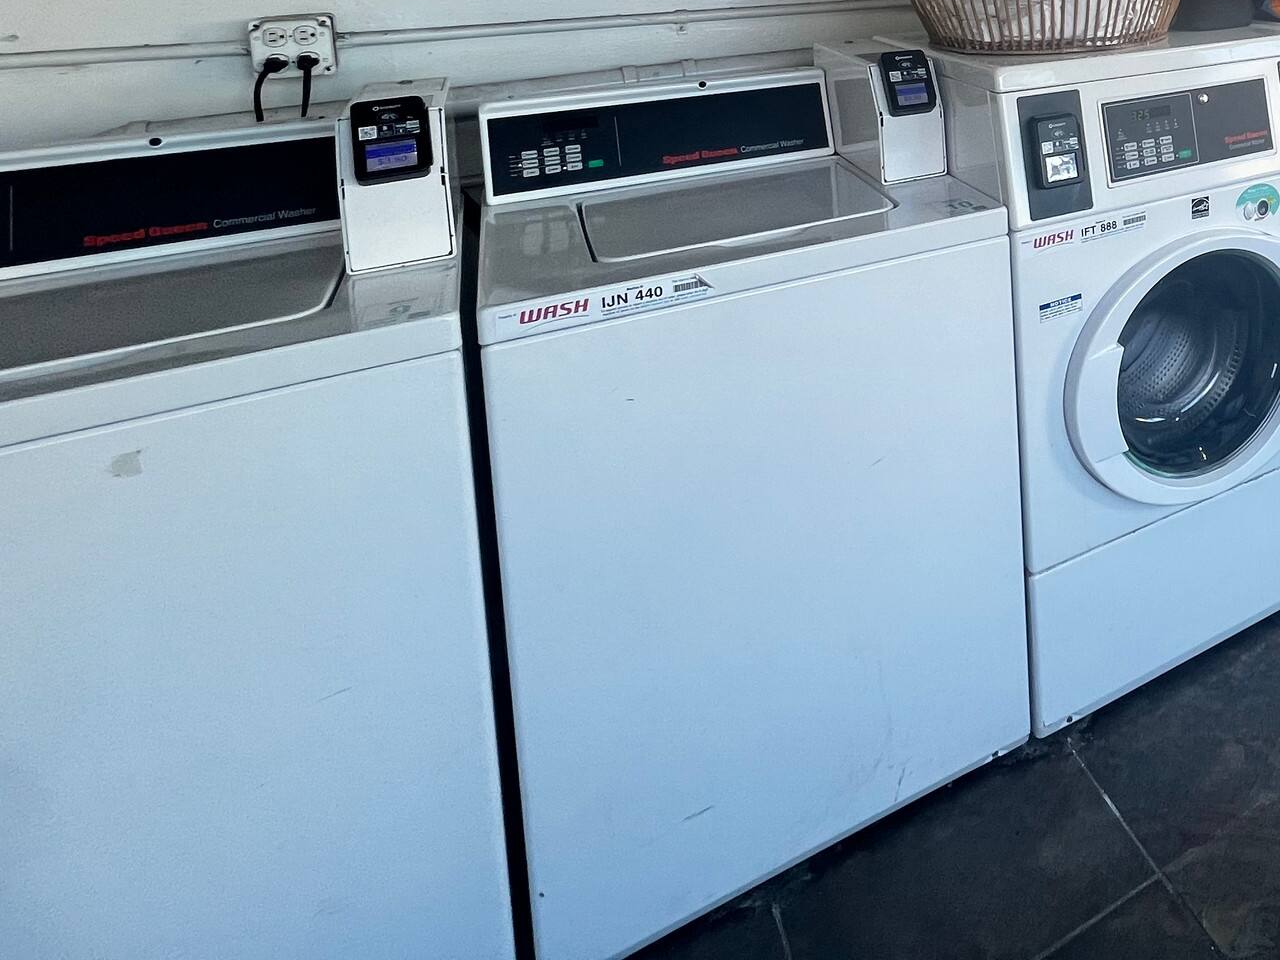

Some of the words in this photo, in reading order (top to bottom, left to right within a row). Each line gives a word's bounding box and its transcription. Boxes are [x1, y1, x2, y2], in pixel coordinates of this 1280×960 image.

[740, 141, 779, 153] Commercial
[213, 212, 276, 229] Commercial
[277, 207, 316, 219] Washer
[1033, 229, 1074, 249] WASH
[1081, 225, 1097, 238] IFT
[1100, 220, 1118, 233] 888
[601, 292, 629, 309] IJN
[635, 286, 663, 302] 440
[519, 298, 590, 325] WASH
